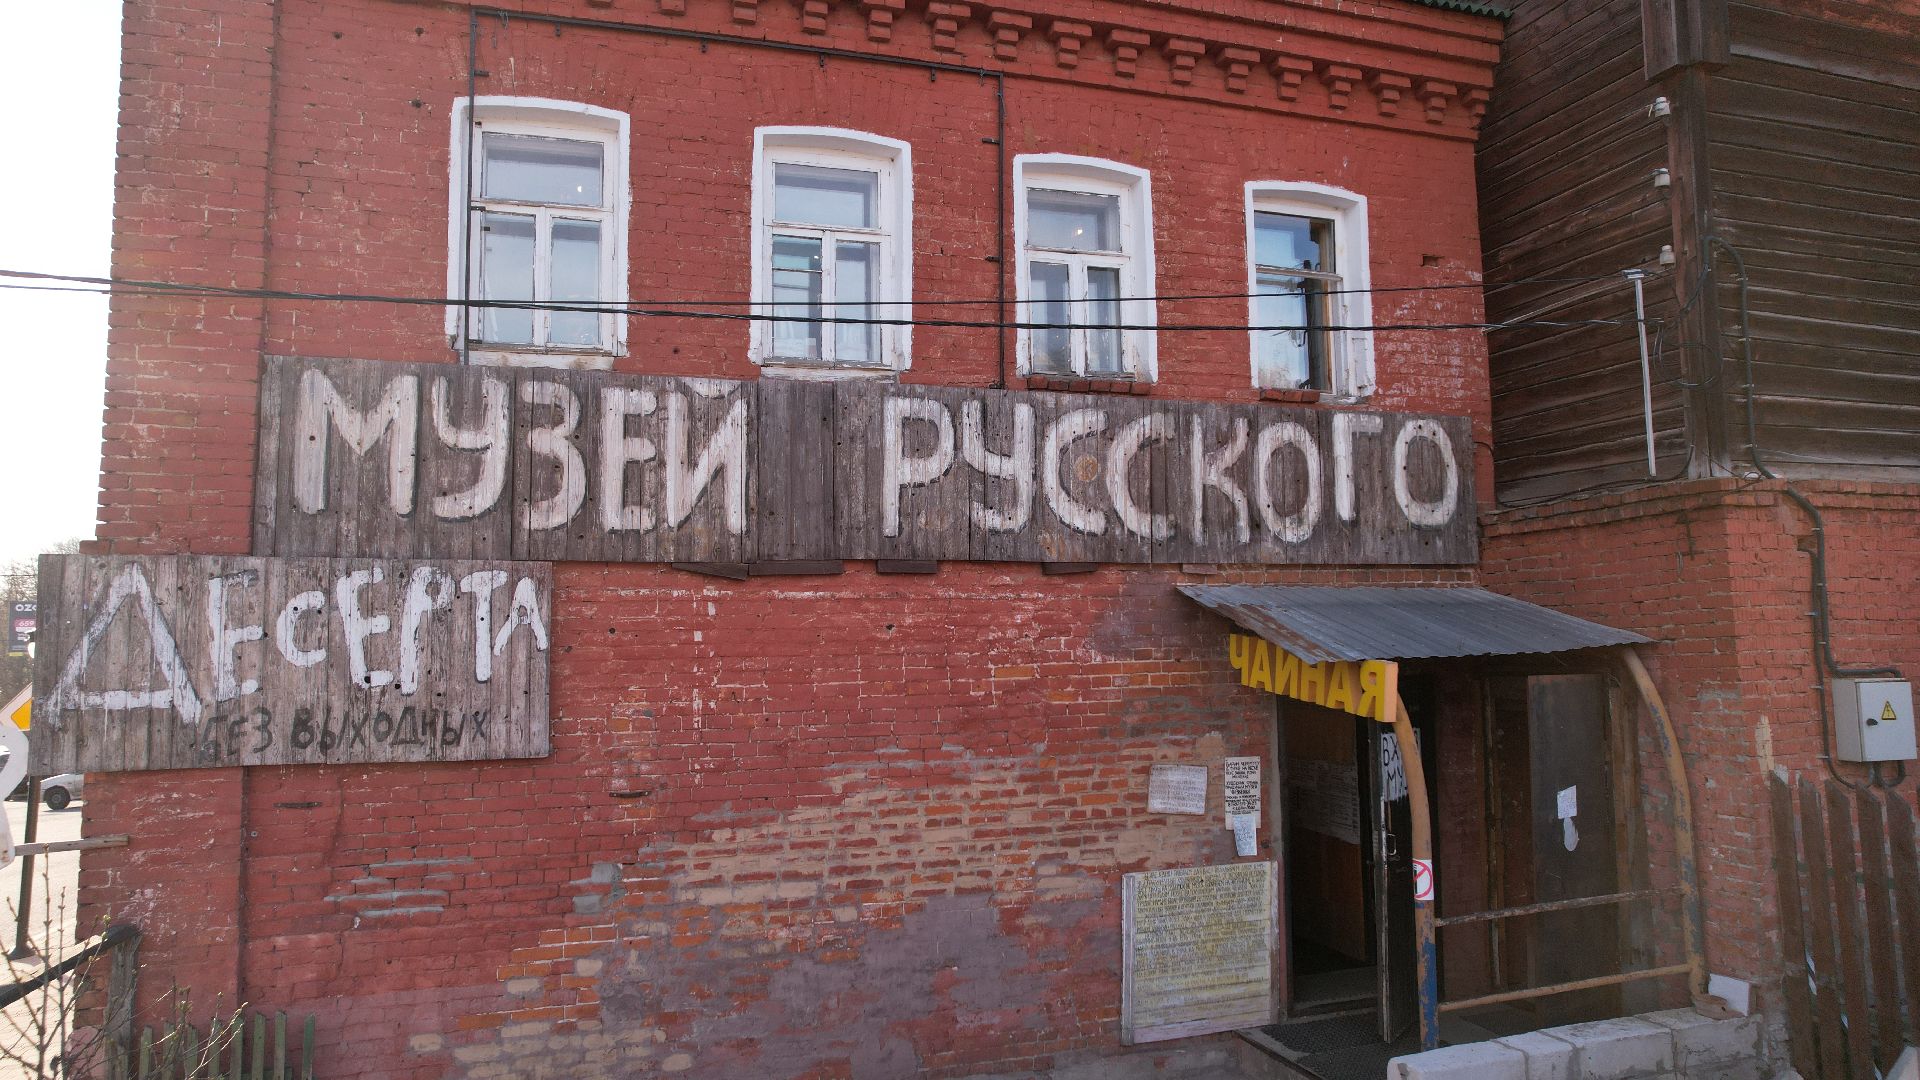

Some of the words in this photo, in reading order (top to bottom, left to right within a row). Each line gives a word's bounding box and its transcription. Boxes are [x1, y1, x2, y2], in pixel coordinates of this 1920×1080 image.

[294, 368, 748, 536] МУЗЕЙ
[881, 397, 1460, 545] РУССКОГО
[47, 561, 549, 727] ДЕСЕРТА
[201, 707, 274, 761] БЕЗ
[289, 705, 489, 756] ВЫХОДНЫХ
